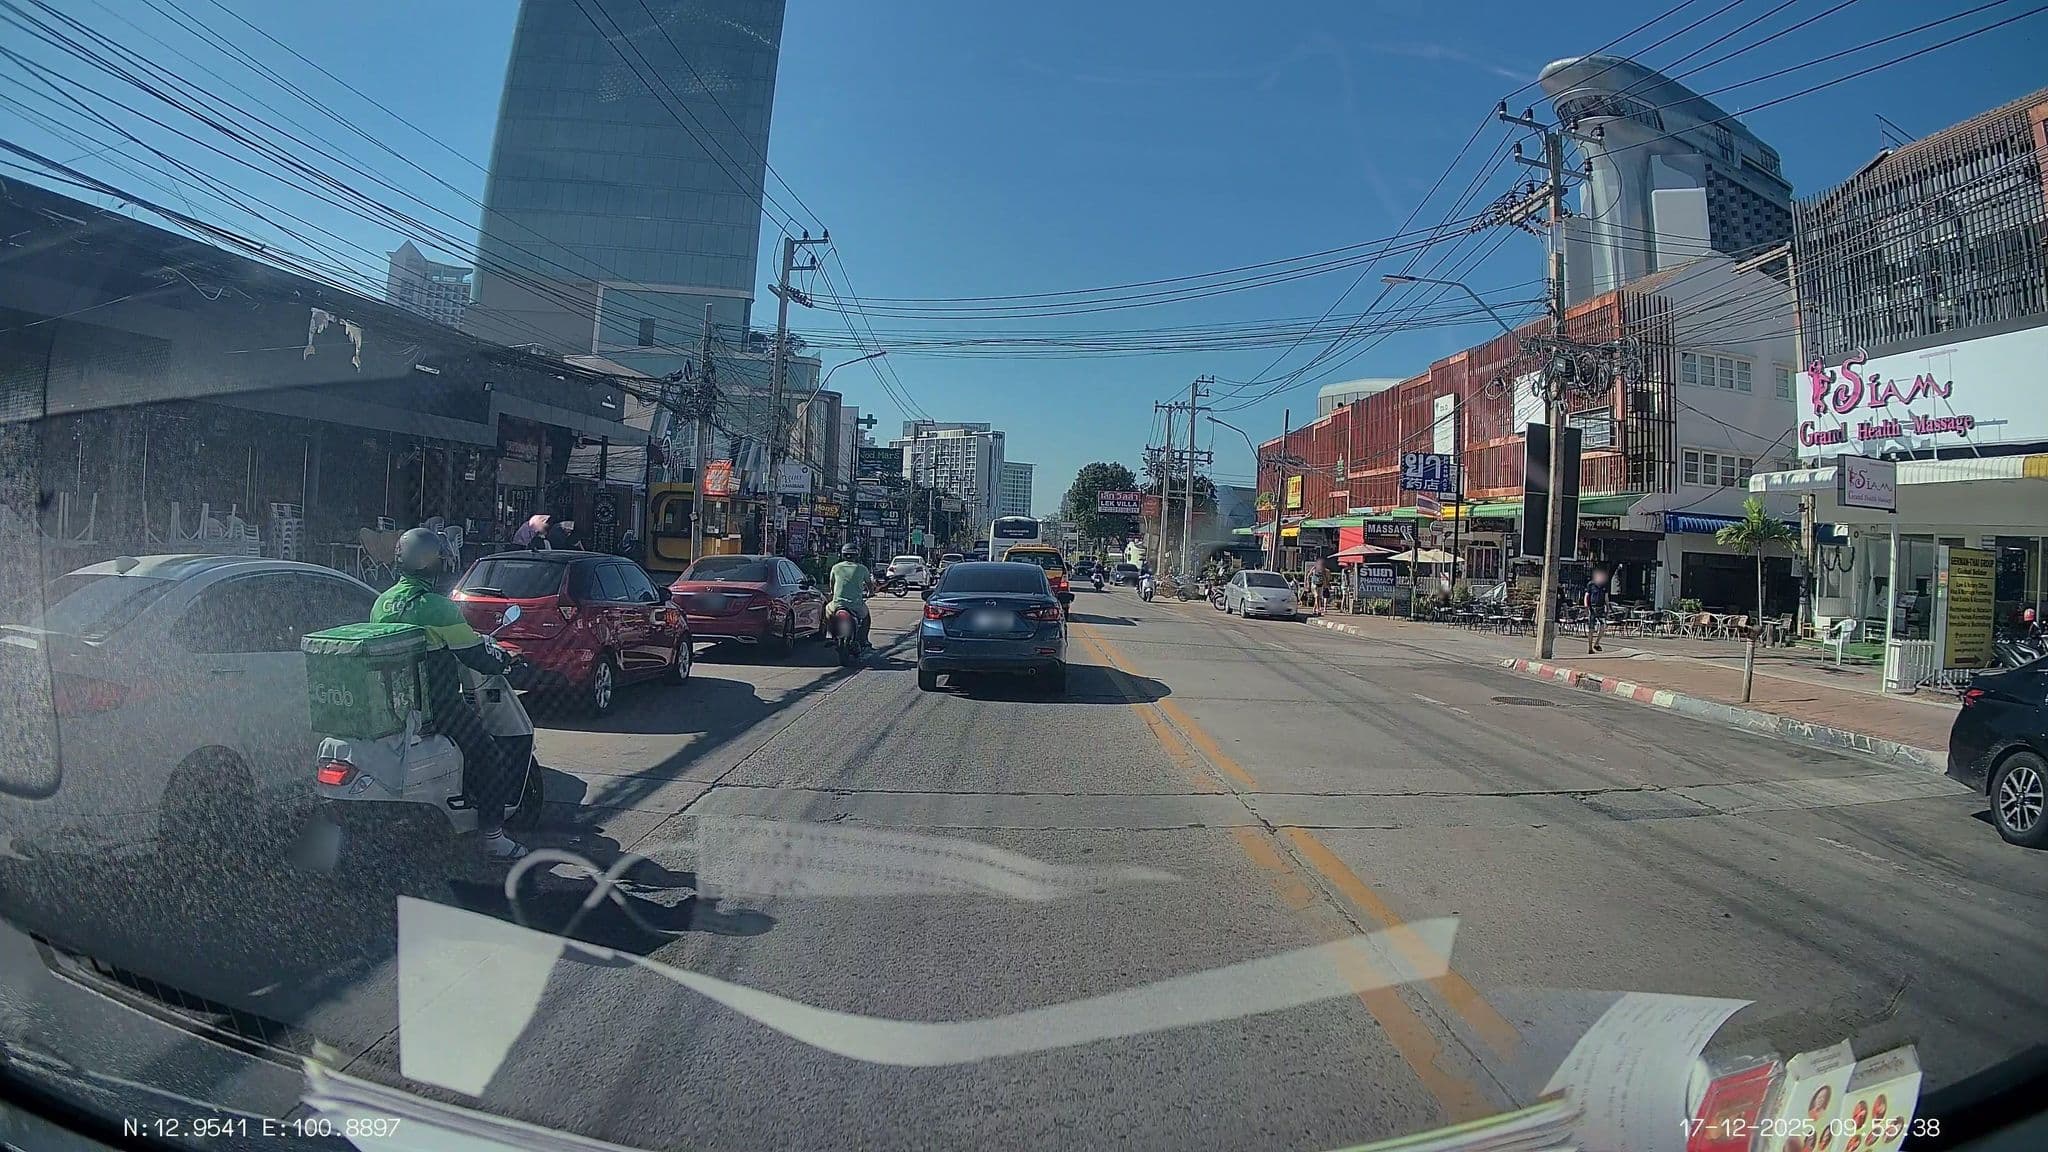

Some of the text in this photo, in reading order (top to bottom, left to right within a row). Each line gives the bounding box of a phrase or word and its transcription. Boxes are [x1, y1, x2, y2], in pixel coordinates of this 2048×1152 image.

[1799, 413, 1975, 447] Grand Health Massage
[1405, 453, 1440, 478] ยา
[1405, 479, 1440, 491] 药店
[815, 502, 839, 514] Honey
[1368, 524, 1412, 534] MASSAGE
[1360, 563, 1393, 577] ร้านยา
[316, 682, 354, 707] Grab
